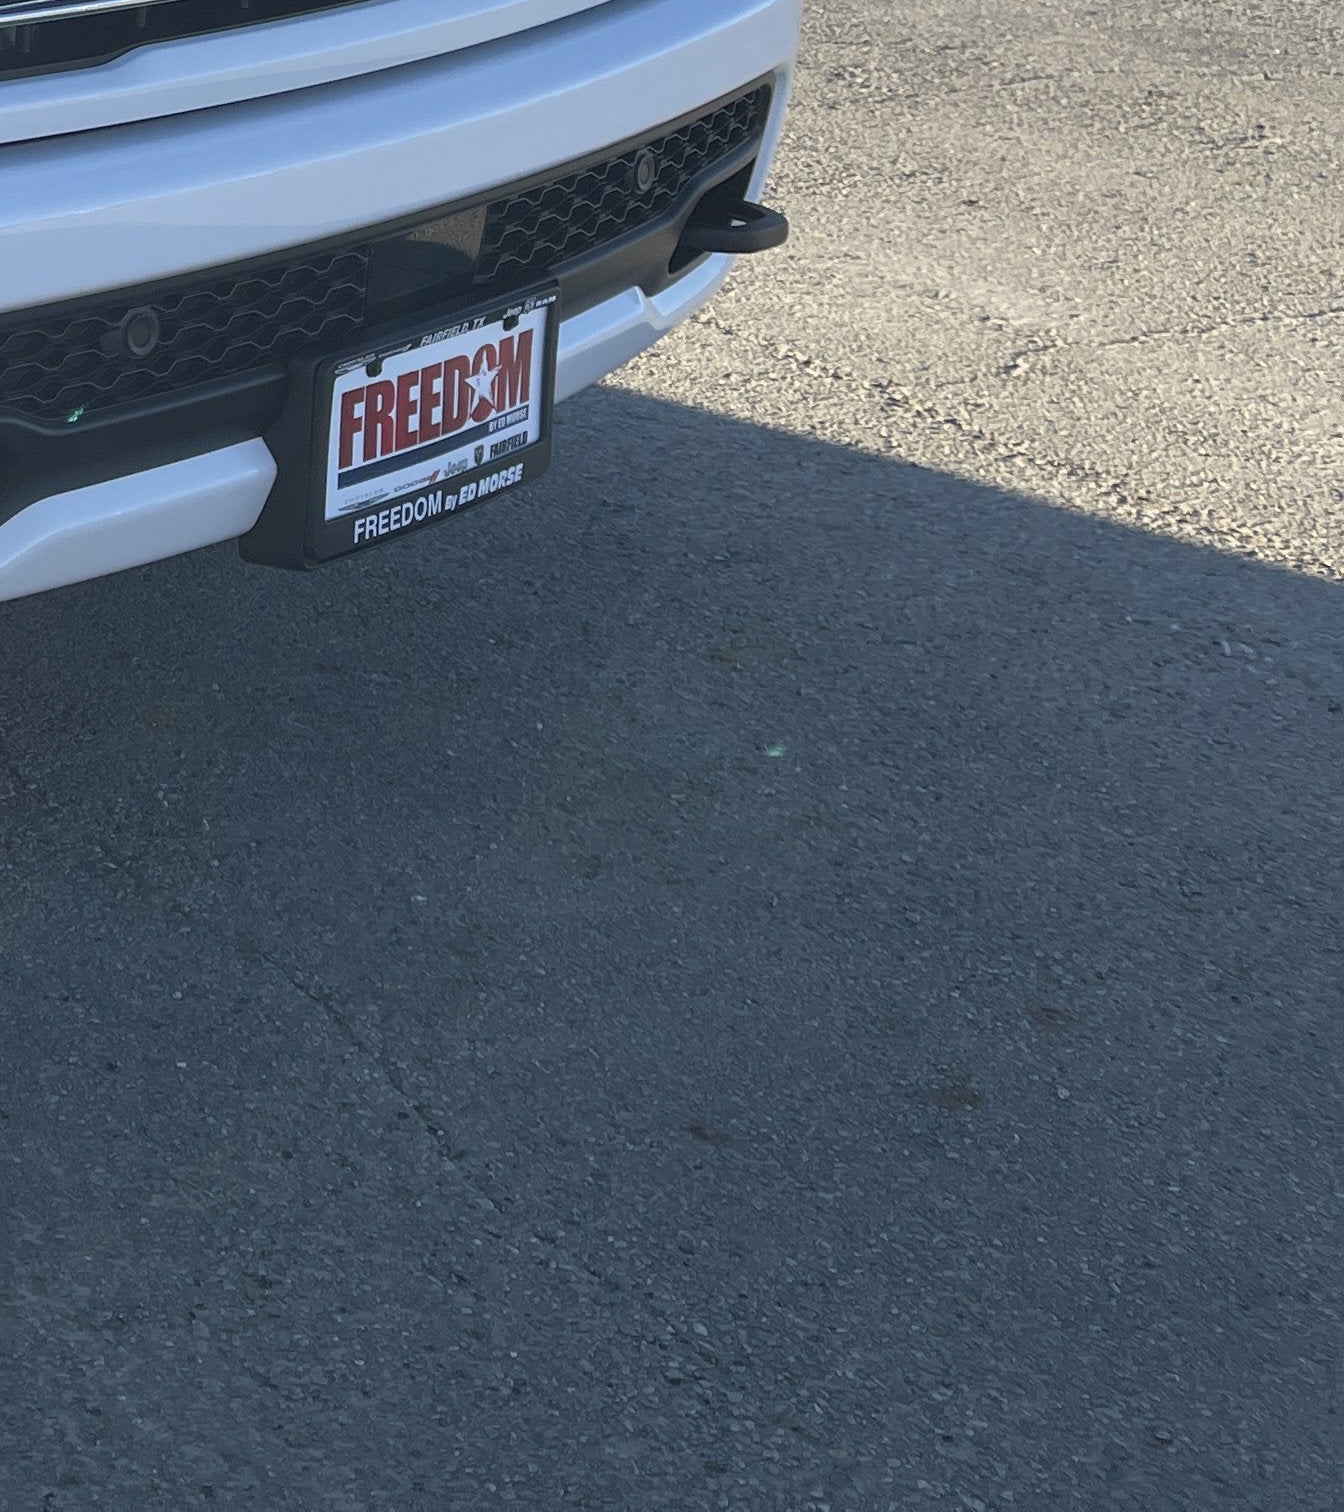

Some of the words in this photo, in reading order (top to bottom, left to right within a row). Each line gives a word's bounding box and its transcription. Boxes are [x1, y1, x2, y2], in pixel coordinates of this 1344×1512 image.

[472, 316, 487, 330] TX
[338, 328, 534, 470] FREEDOM
[489, 430, 529, 459] FAIRFIELD
[353, 490, 443, 544] FREEDOM
[444, 494, 458, 511] By
[458, 483, 478, 506] ED
[477, 463, 524, 498] MORSE
